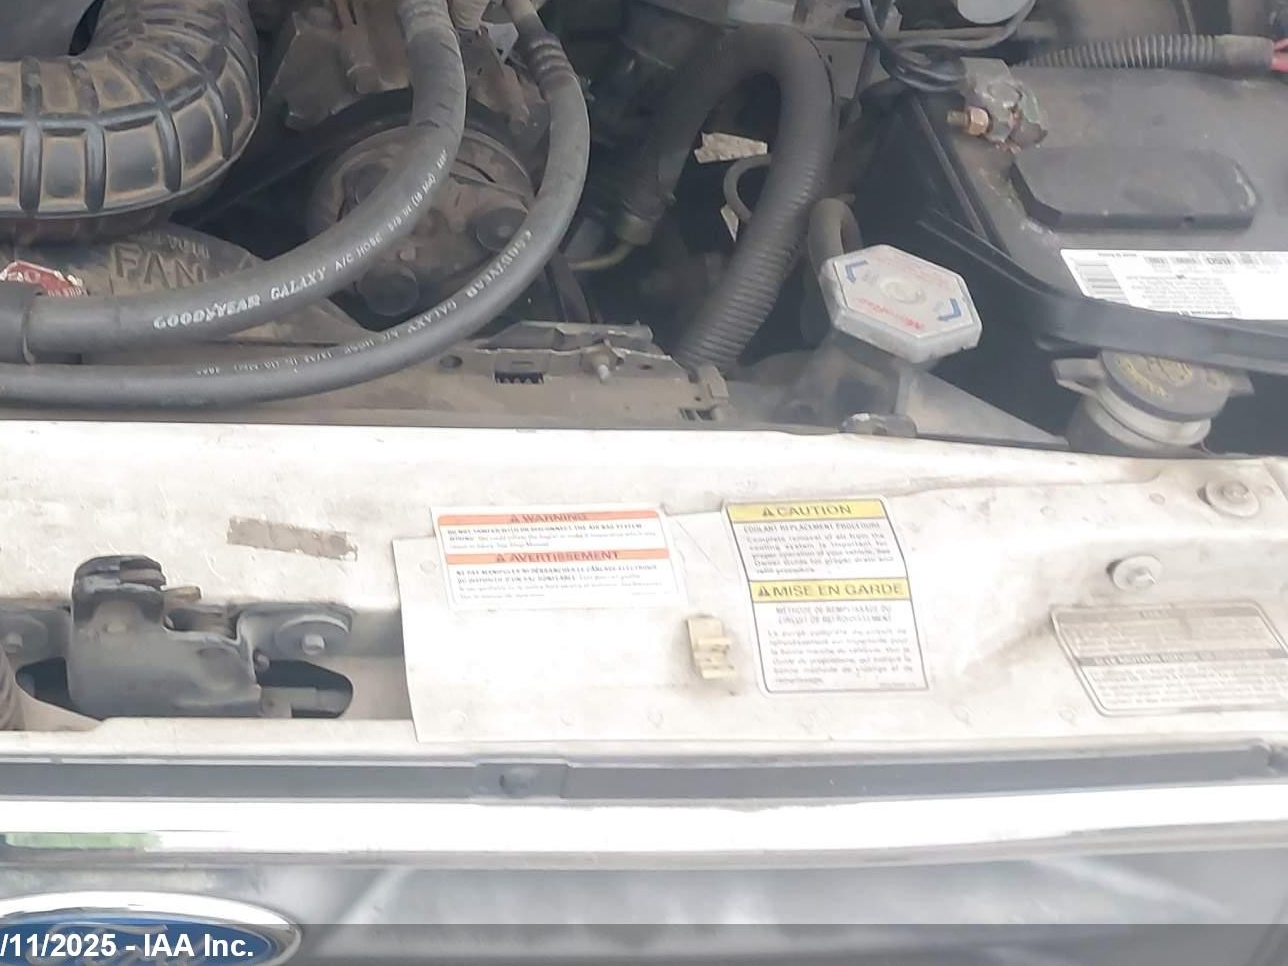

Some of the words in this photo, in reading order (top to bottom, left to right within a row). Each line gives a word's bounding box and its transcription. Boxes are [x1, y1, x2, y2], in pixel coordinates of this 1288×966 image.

[114, 242, 209, 288] FAN
[153, 294, 261, 330] GOODYEAR
[270, 266, 326, 301] GALAXY
[334, 254, 354, 272] A/C
[776, 504, 852, 517] CAUTION
[522, 512, 588, 524] WARNING
[509, 550, 620, 563] AVERTISSEMENT
[773, 585, 810, 597] MISE
[818, 585, 840, 597] EN
[845, 583, 904, 596] GARDE
